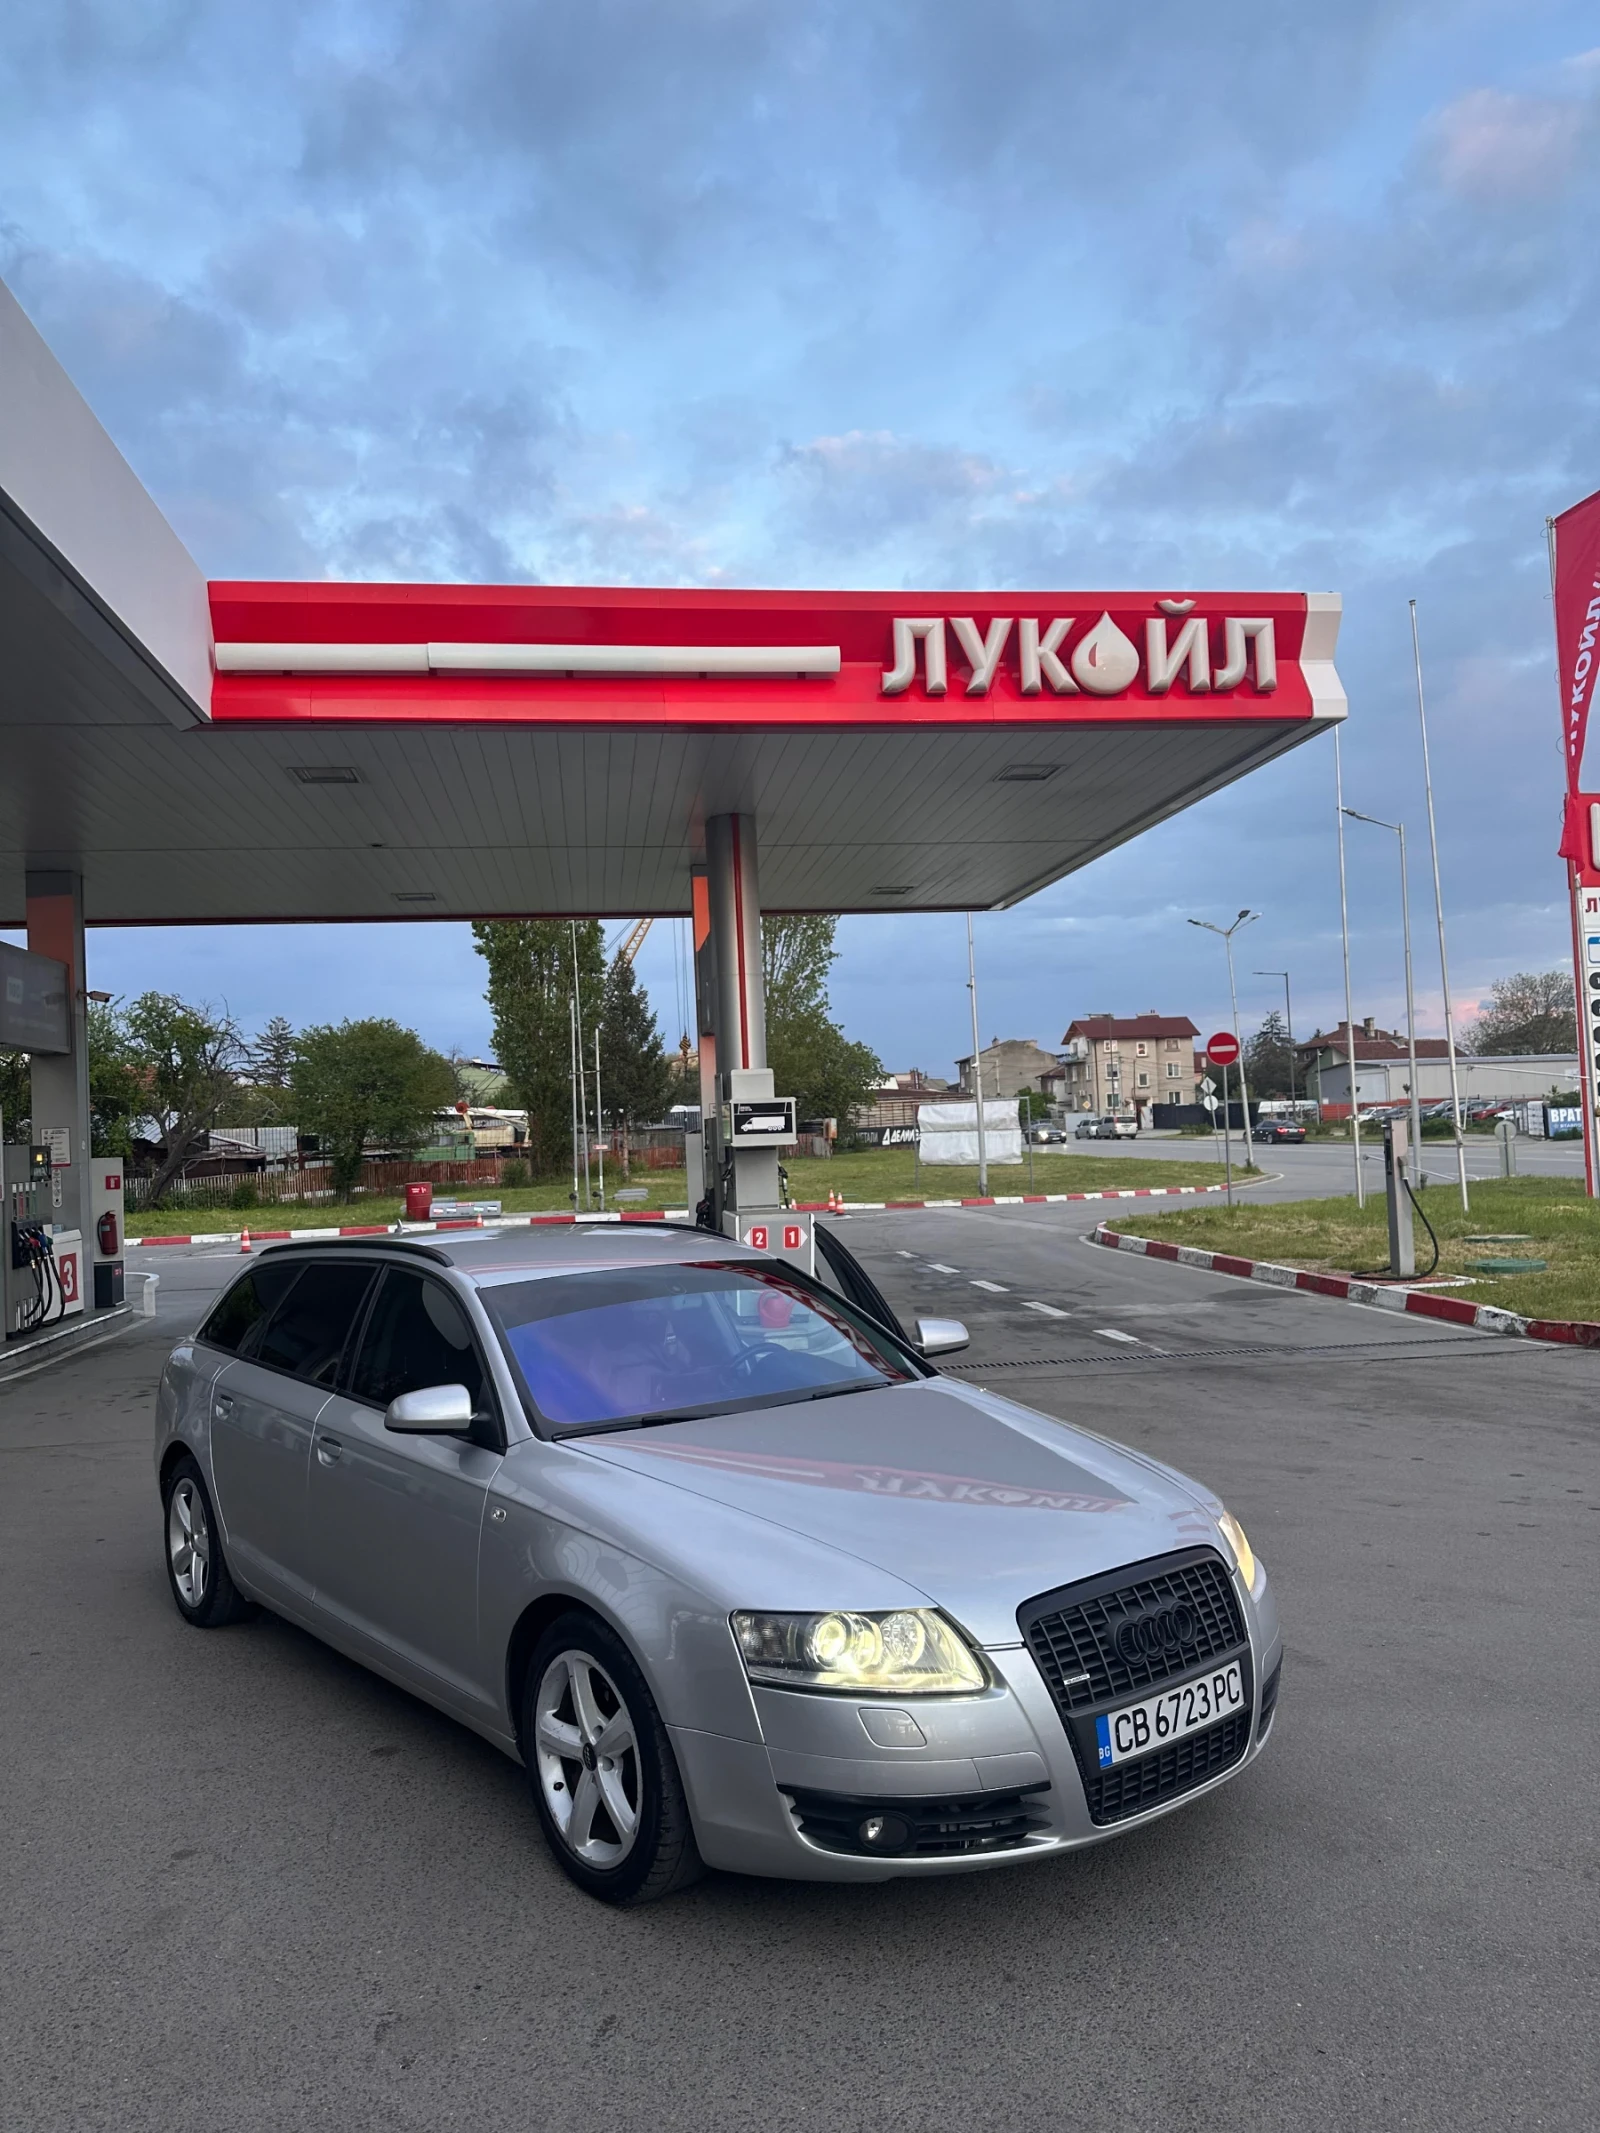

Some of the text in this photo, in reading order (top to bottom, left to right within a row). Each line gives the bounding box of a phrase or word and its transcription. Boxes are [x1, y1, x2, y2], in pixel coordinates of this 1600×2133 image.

[882, 598, 1278, 695] ЛУКОЙЛ
[1550, 1108, 1582, 1123] ВРАТ
[755, 1231, 764, 1245] 2
[788, 1231, 796, 1244] 1
[63, 1260, 74, 1297] 3
[1155, 1682, 1211, 1738] 6723
[1099, 1745, 1112, 1760] BG
